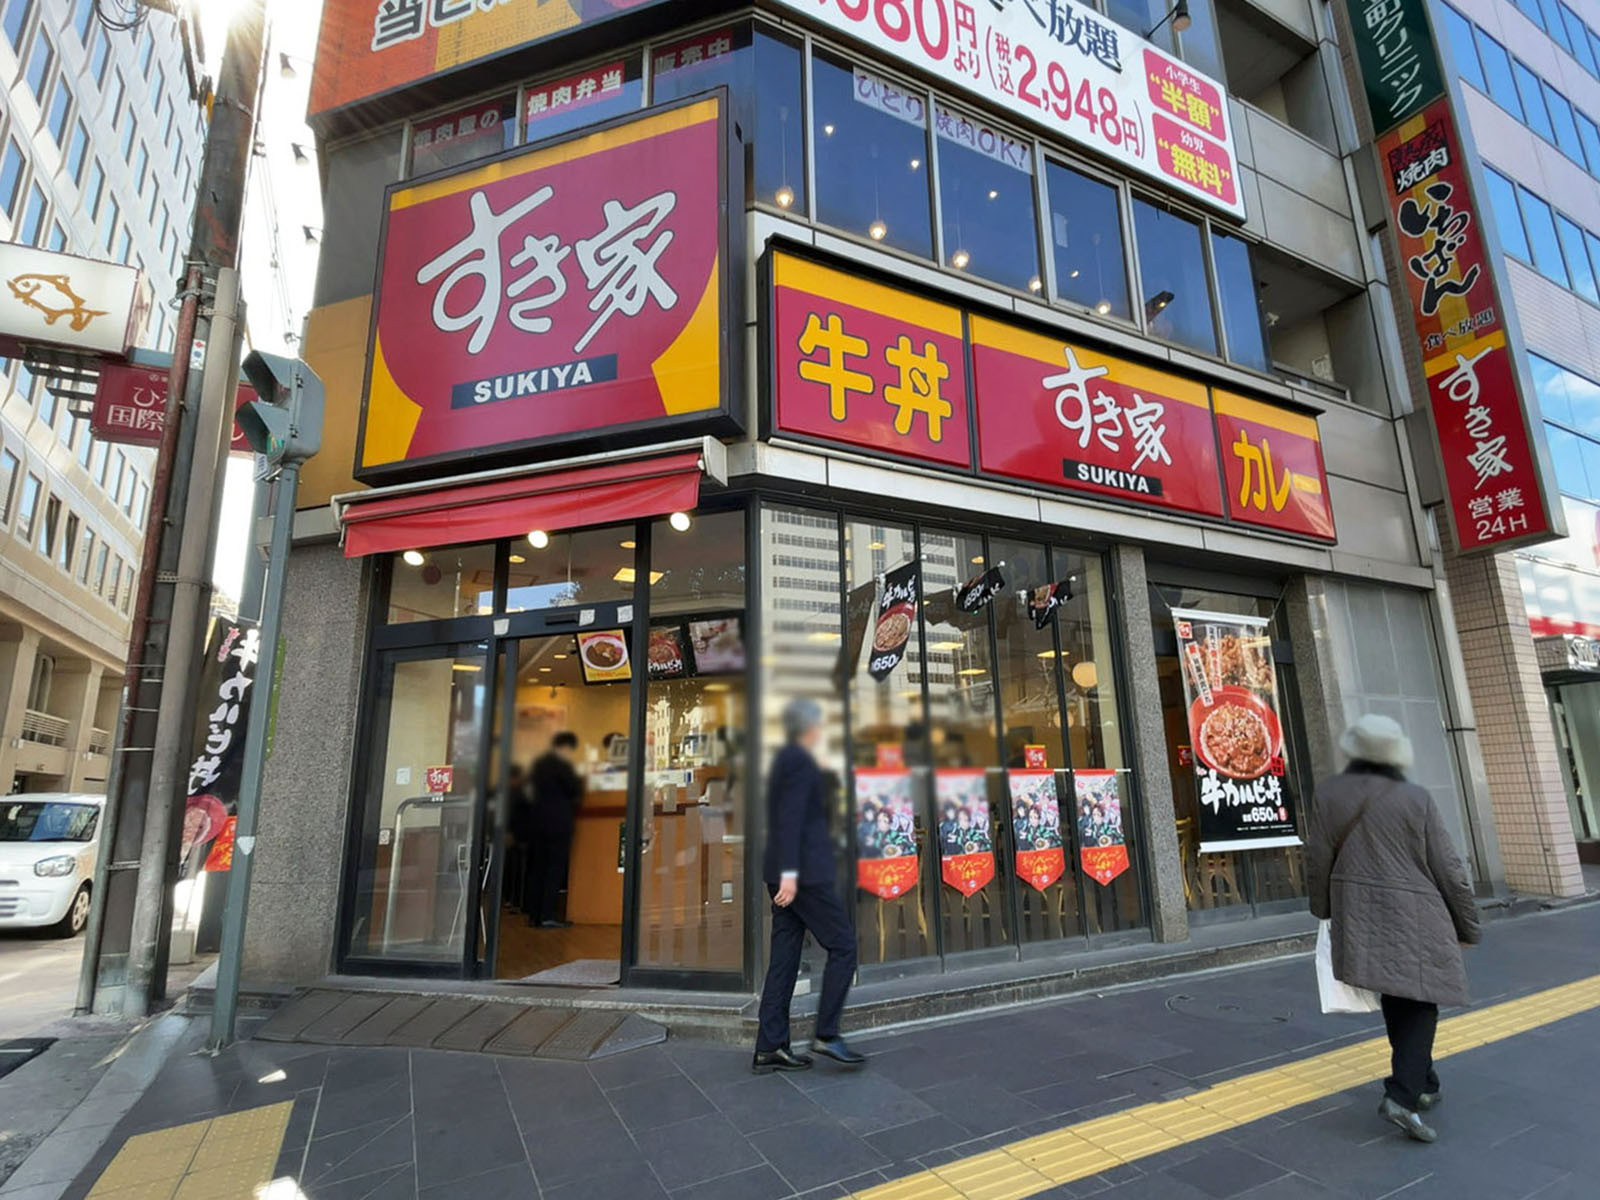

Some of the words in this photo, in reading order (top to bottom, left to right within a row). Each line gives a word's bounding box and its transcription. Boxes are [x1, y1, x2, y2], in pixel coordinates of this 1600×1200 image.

[528, 70, 622, 115] 焼肉弁当
[857, 75, 924, 121] ひとり
[1397, 147, 1449, 193] 焼肉
[416, 184, 679, 355] すき家
[473, 361, 593, 404] SUKIYA
[799, 312, 952, 443] 牛丼
[1042, 346, 1172, 471] すき家
[1439, 347, 1514, 490] すき家
[1077, 463, 1150, 493] SUKIYA
[1233, 429, 1321, 512] カレー
[1468, 487, 1524, 519] 営業
[1476, 513, 1527, 541] 24H
[1201, 769, 1282, 816] 牛カルビ丼
